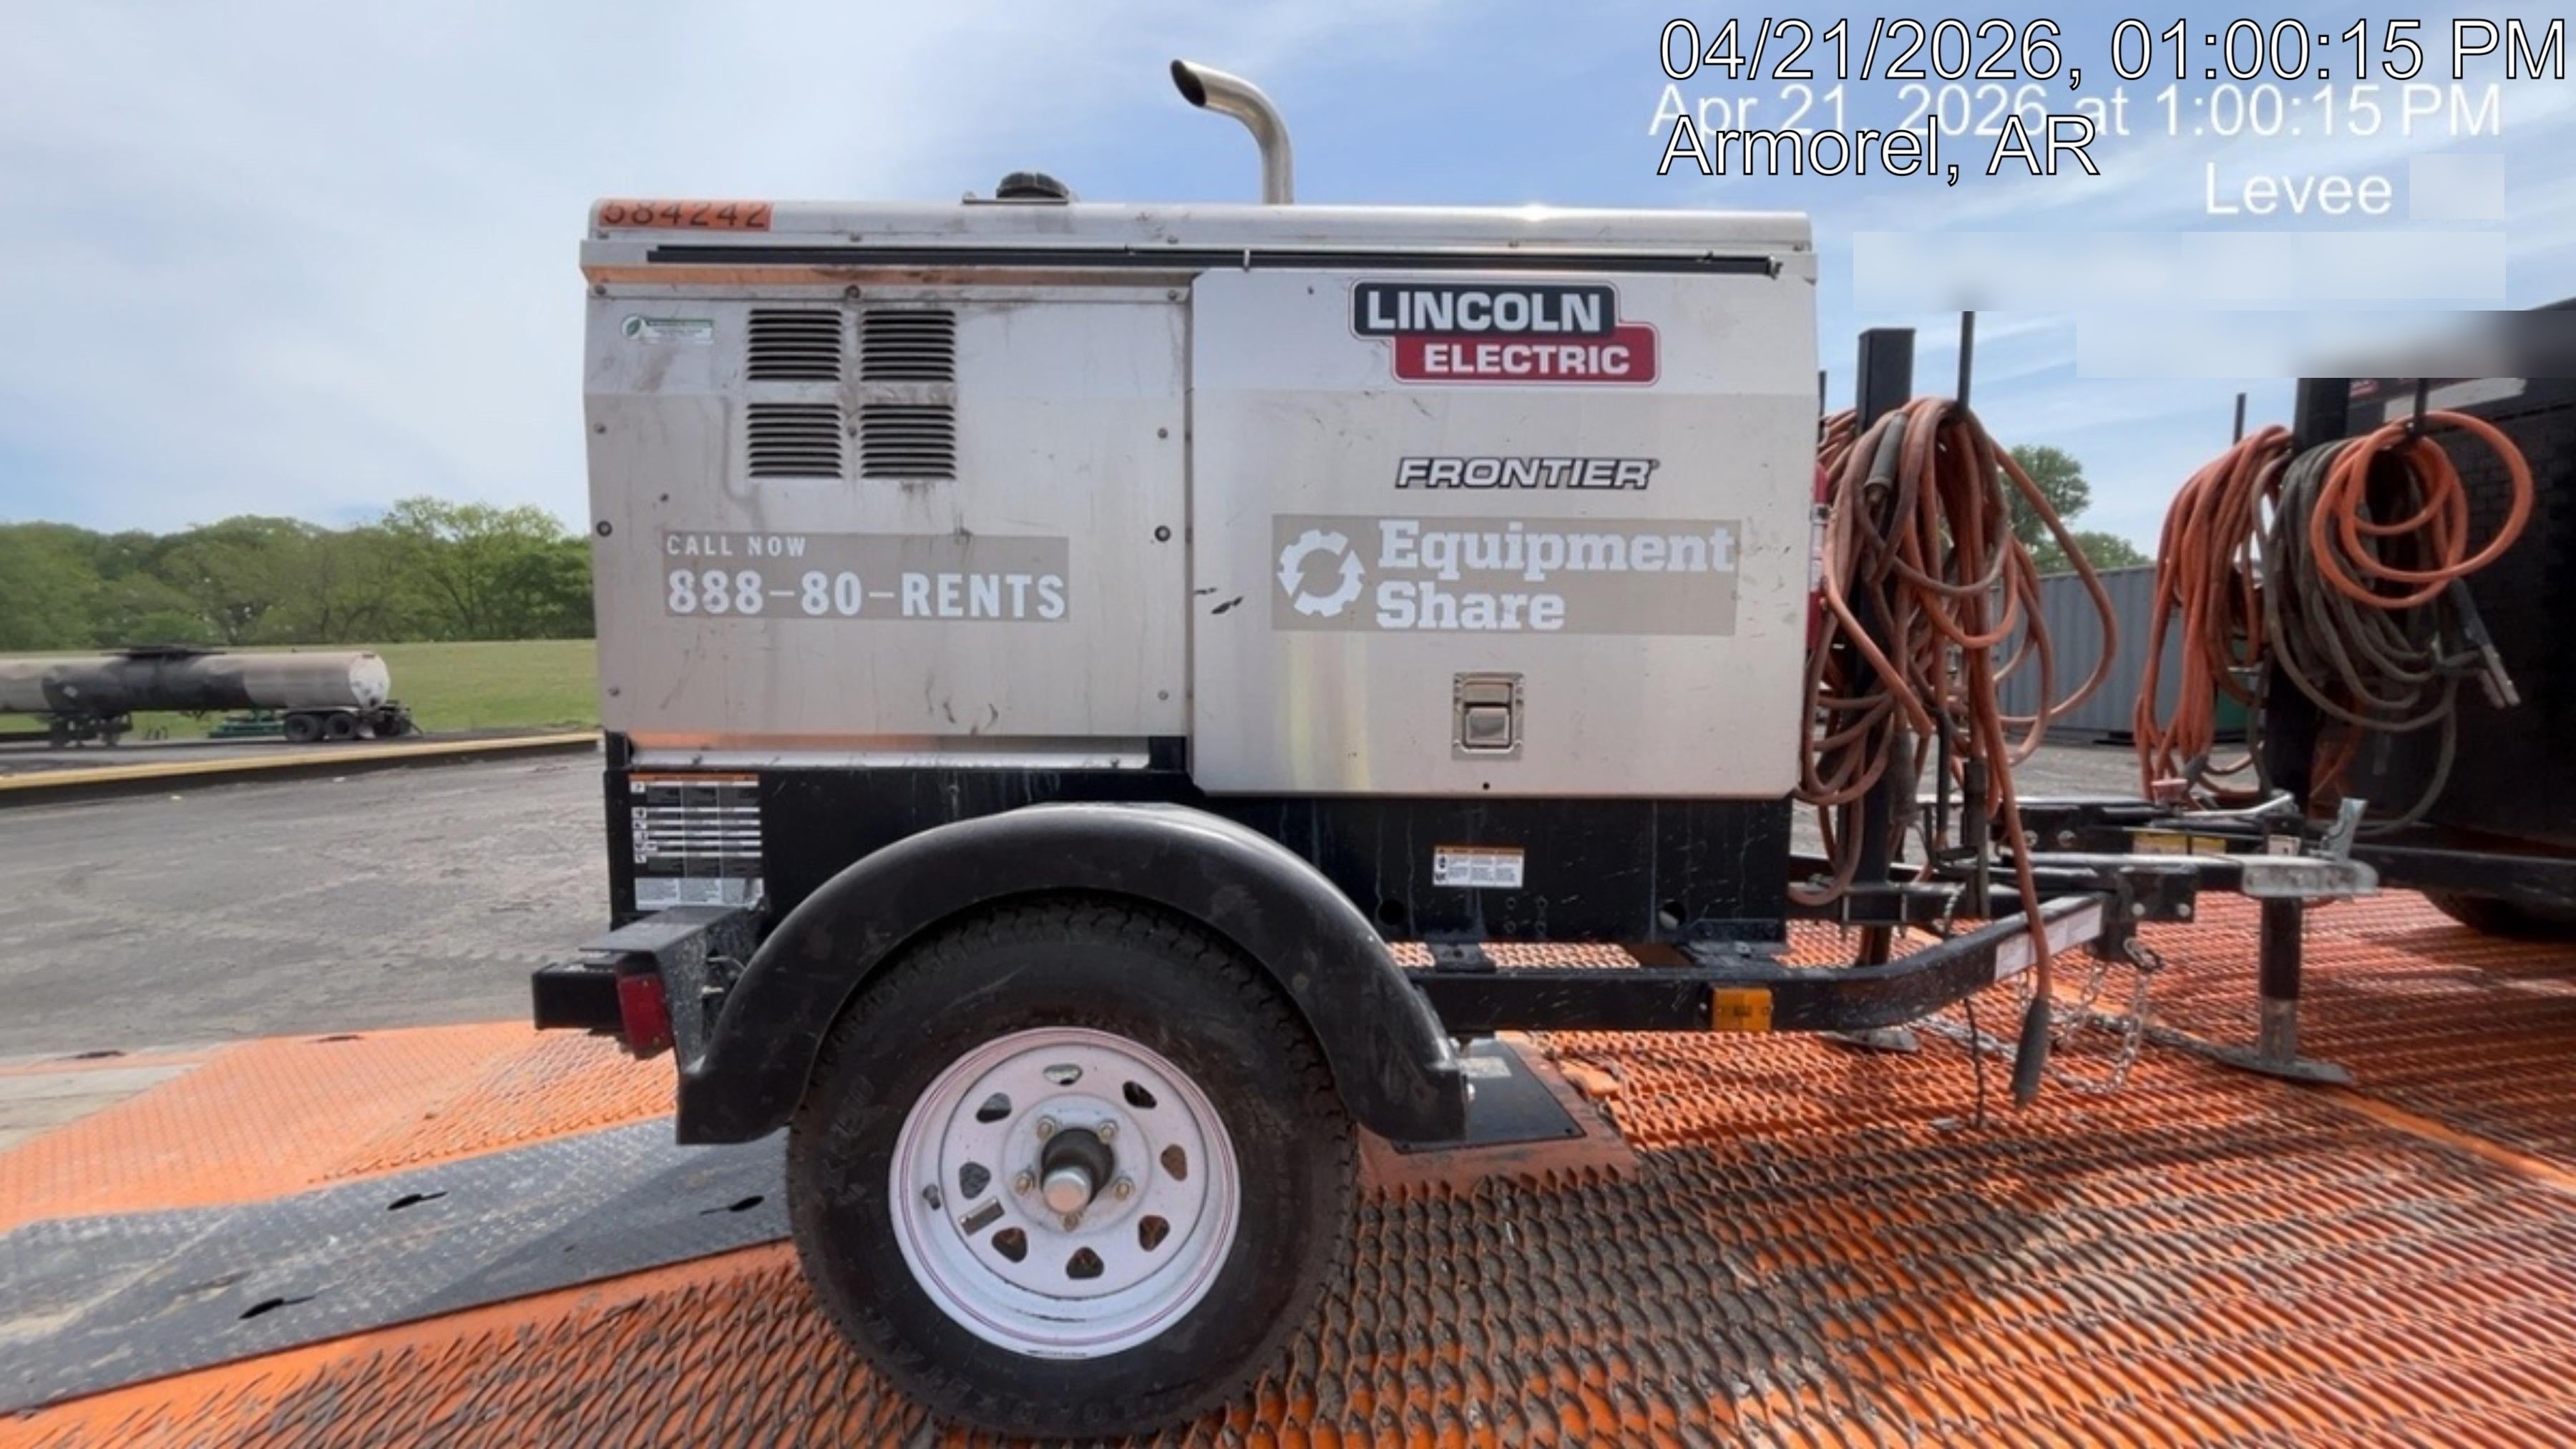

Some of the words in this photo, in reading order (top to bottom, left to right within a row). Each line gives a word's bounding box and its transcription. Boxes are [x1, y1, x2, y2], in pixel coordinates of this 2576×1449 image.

[1367, 291, 1601, 333] LINCOLN
[1423, 343, 1631, 375] ELECTRIC
[666, 535, 733, 556] CALL
[748, 535, 806, 557] NOW
[1377, 519, 1735, 582] Equipment
[668, 569, 1066, 620] 888-80-RENTS
[1375, 580, 1566, 631] Share
